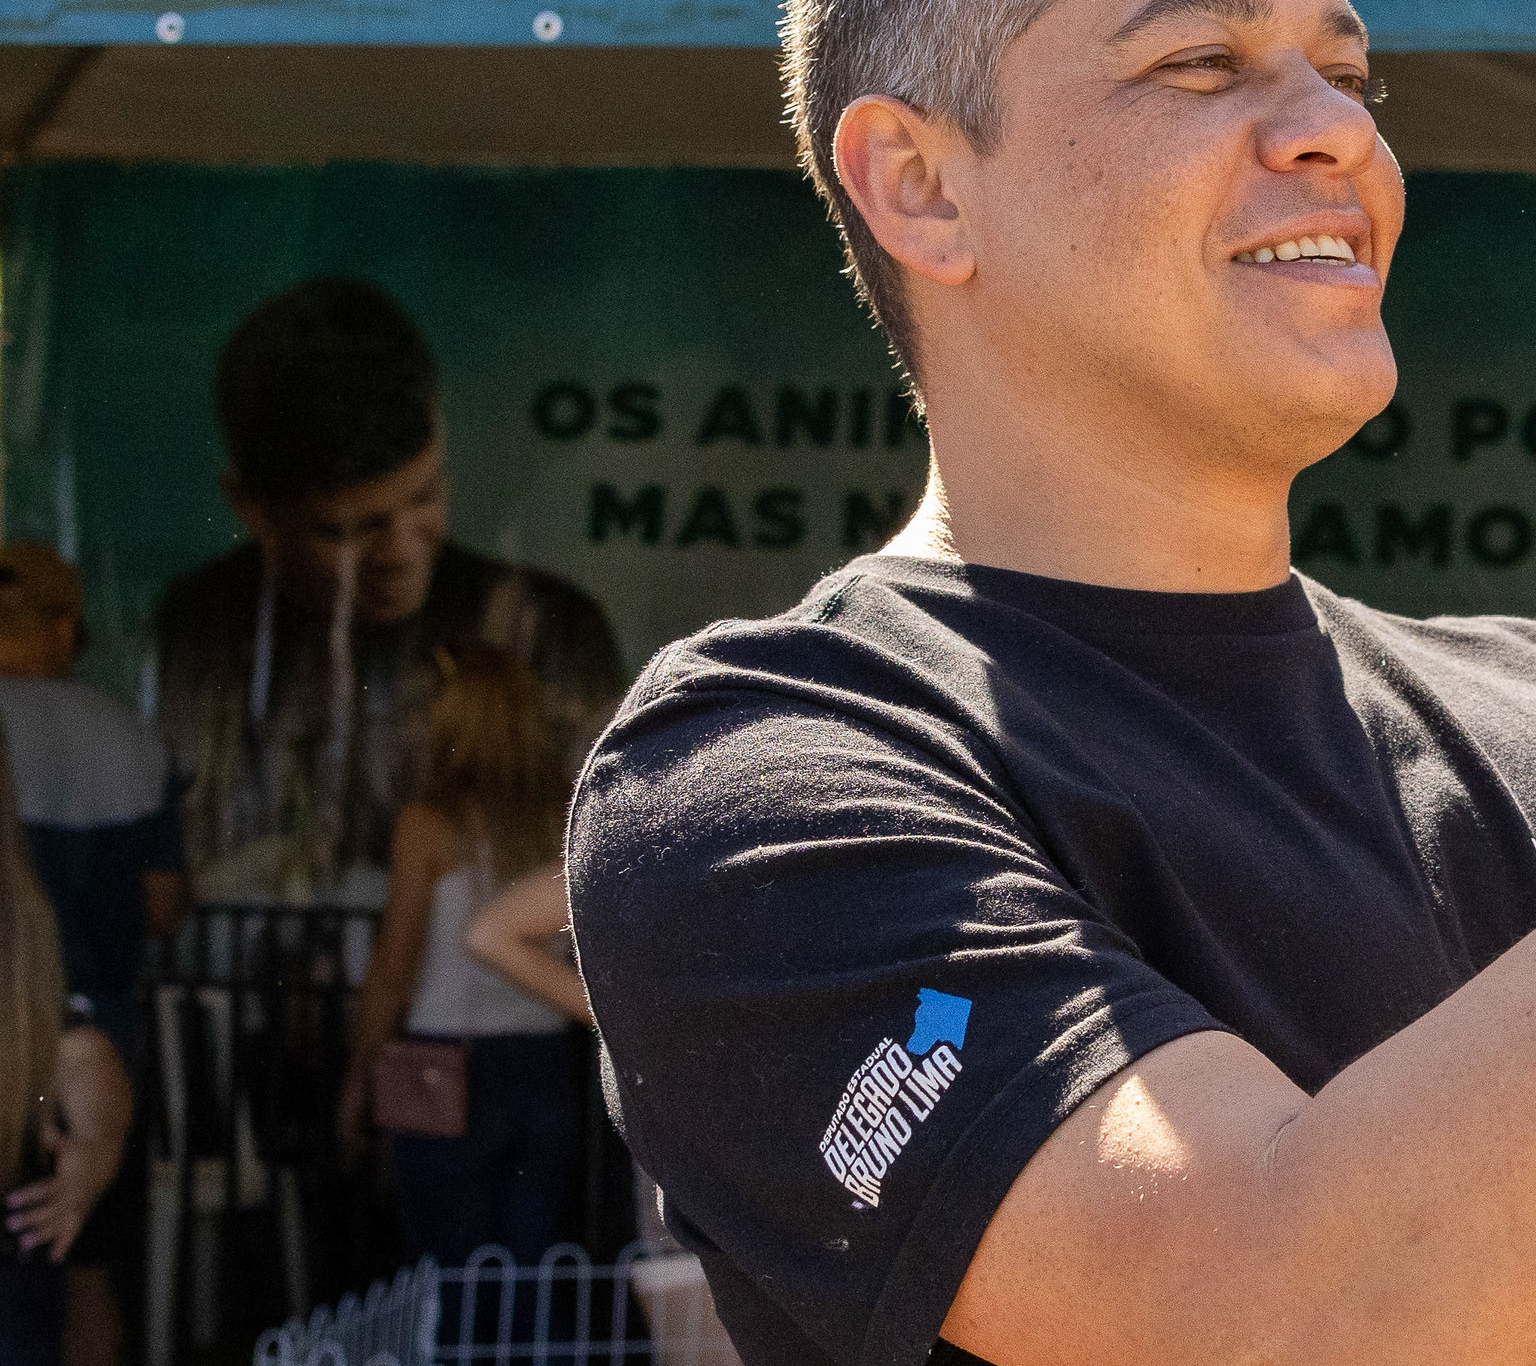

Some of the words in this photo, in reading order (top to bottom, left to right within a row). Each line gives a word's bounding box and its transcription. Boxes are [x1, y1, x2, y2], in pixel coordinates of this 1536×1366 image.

[532, 379, 661, 441] OS
[590, 483, 802, 548] MAS
[819, 1091, 852, 1153] DEPUTADO
[846, 1037, 894, 1095] ESTADUAL
[823, 1043, 914, 1184] DELEGADO
[844, 1105, 913, 1208] BRUNO
[898, 1045, 964, 1123] LIMA
